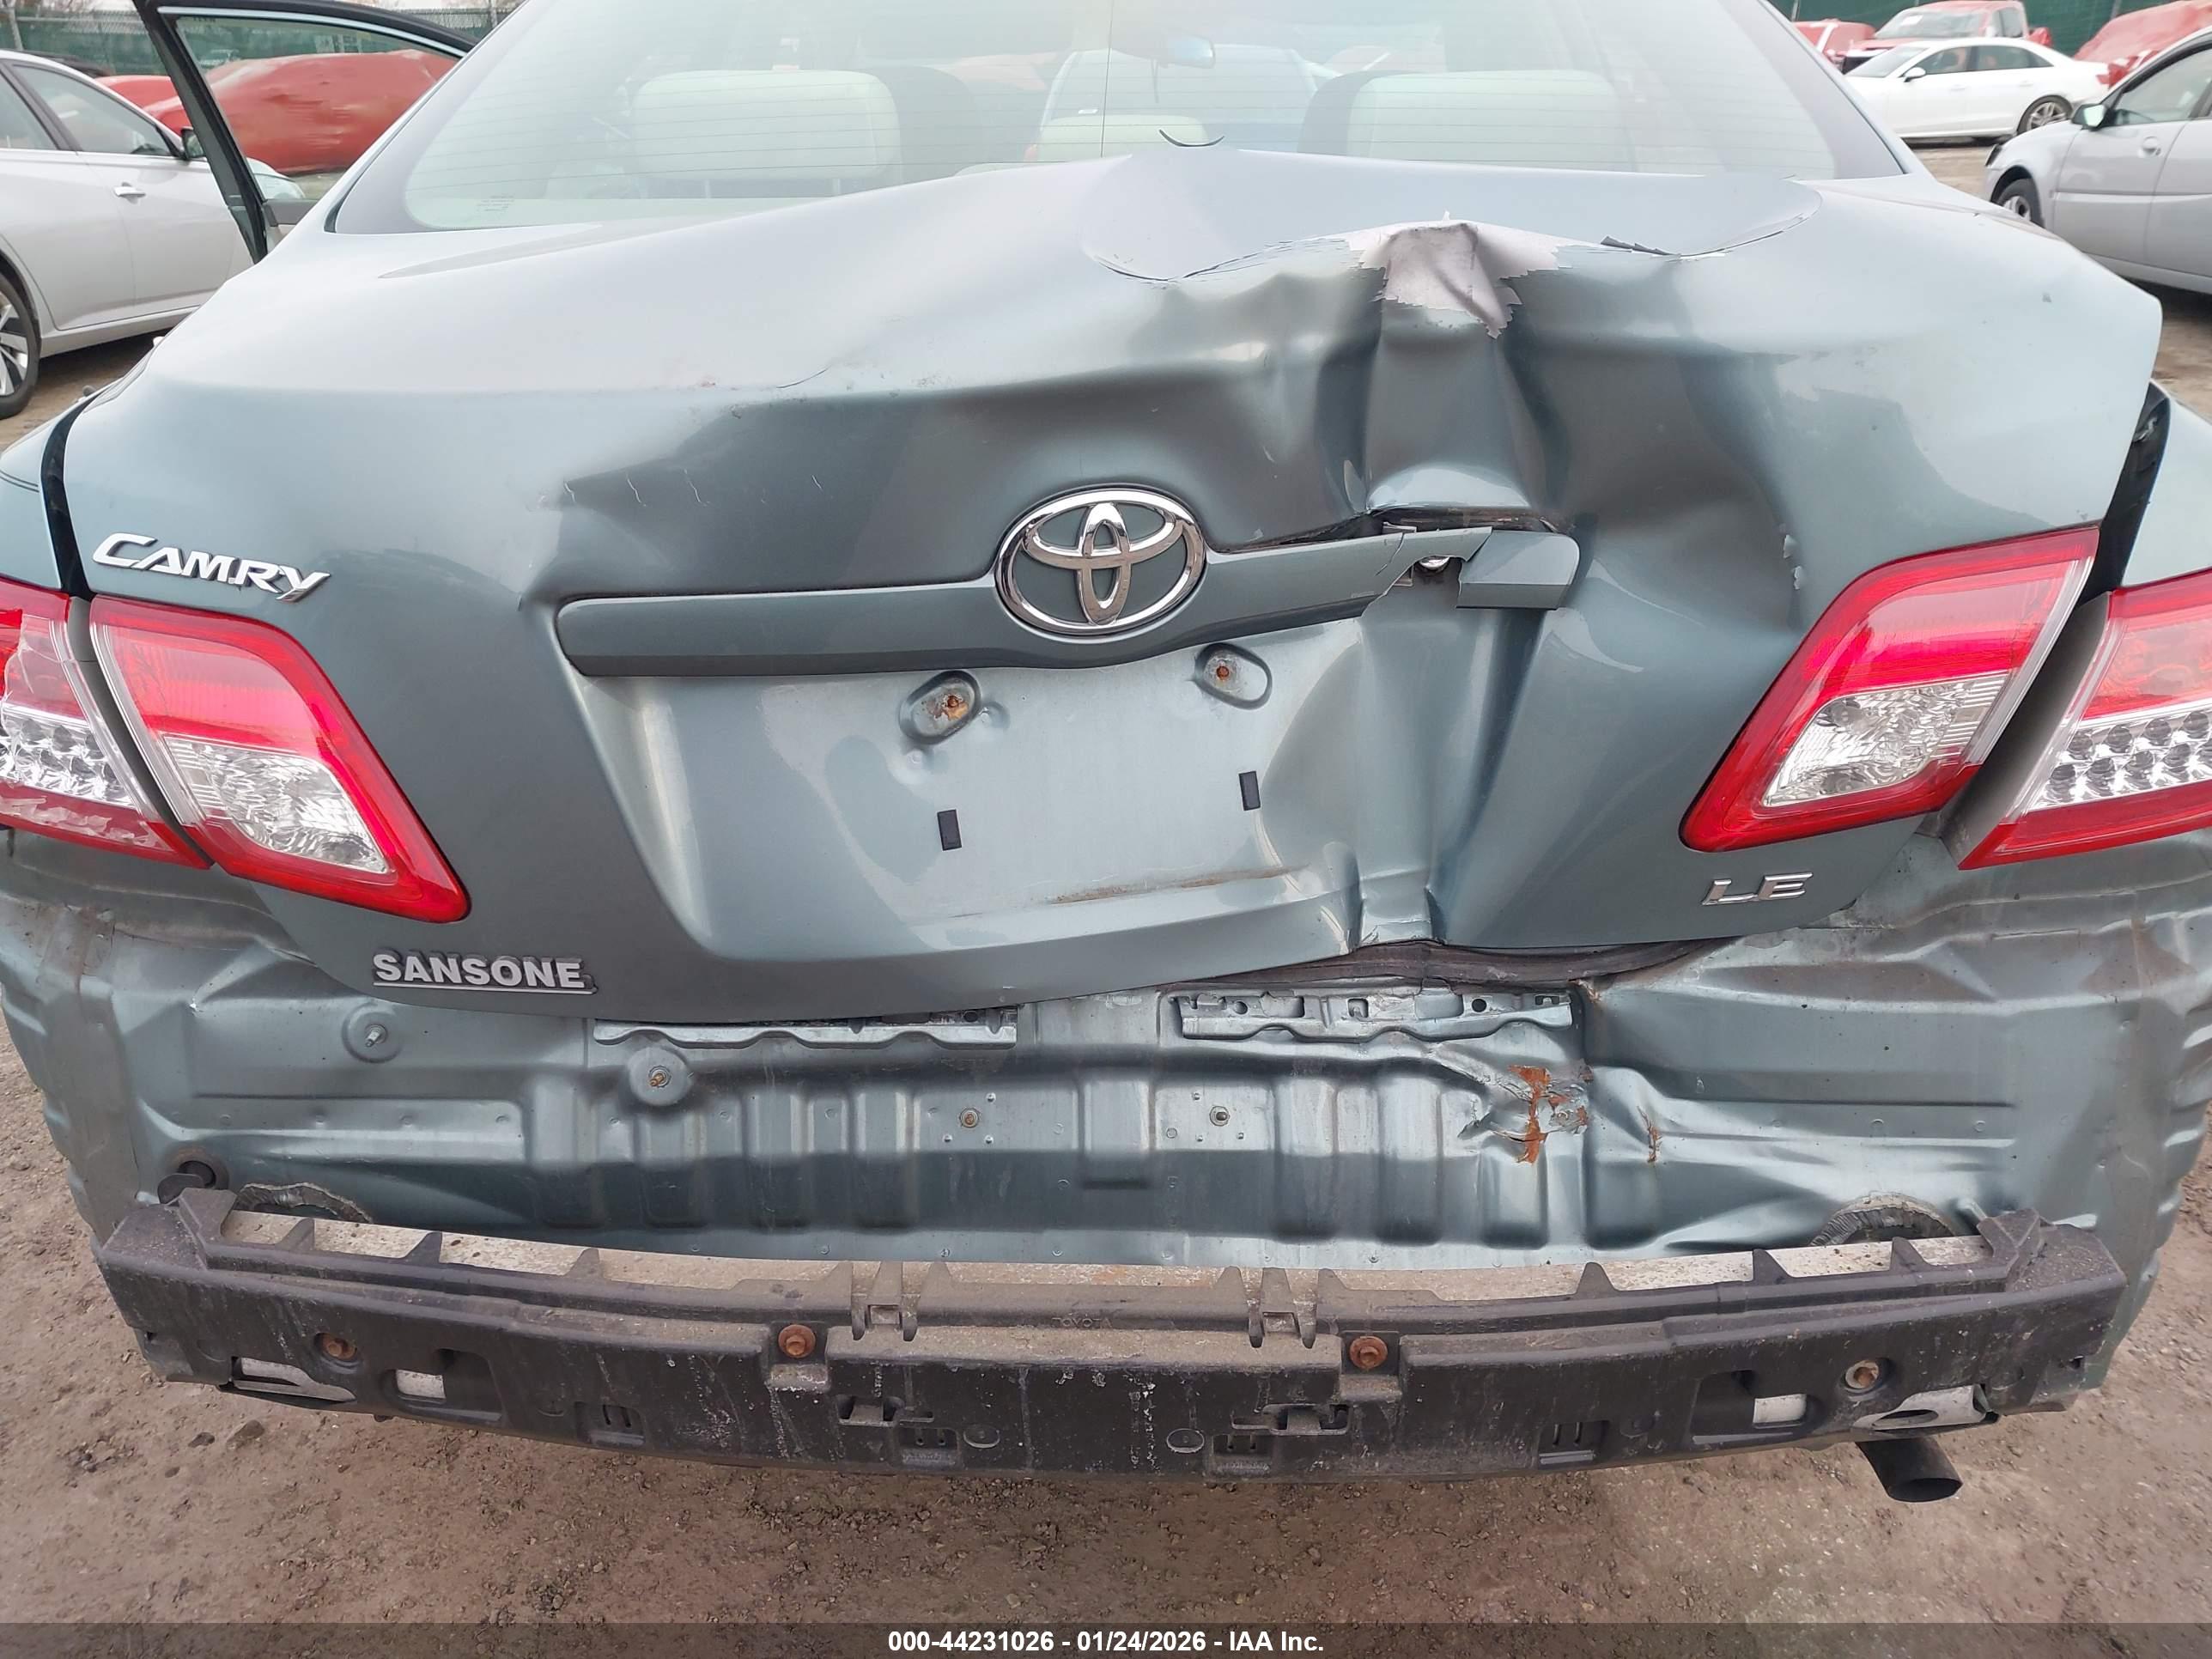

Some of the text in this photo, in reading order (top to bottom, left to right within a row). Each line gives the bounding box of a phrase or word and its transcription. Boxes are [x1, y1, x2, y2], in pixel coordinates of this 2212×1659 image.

[92, 531, 331, 602] CAMRY
[1701, 872, 1814, 906] LE
[372, 951, 589, 988] SANSONE
